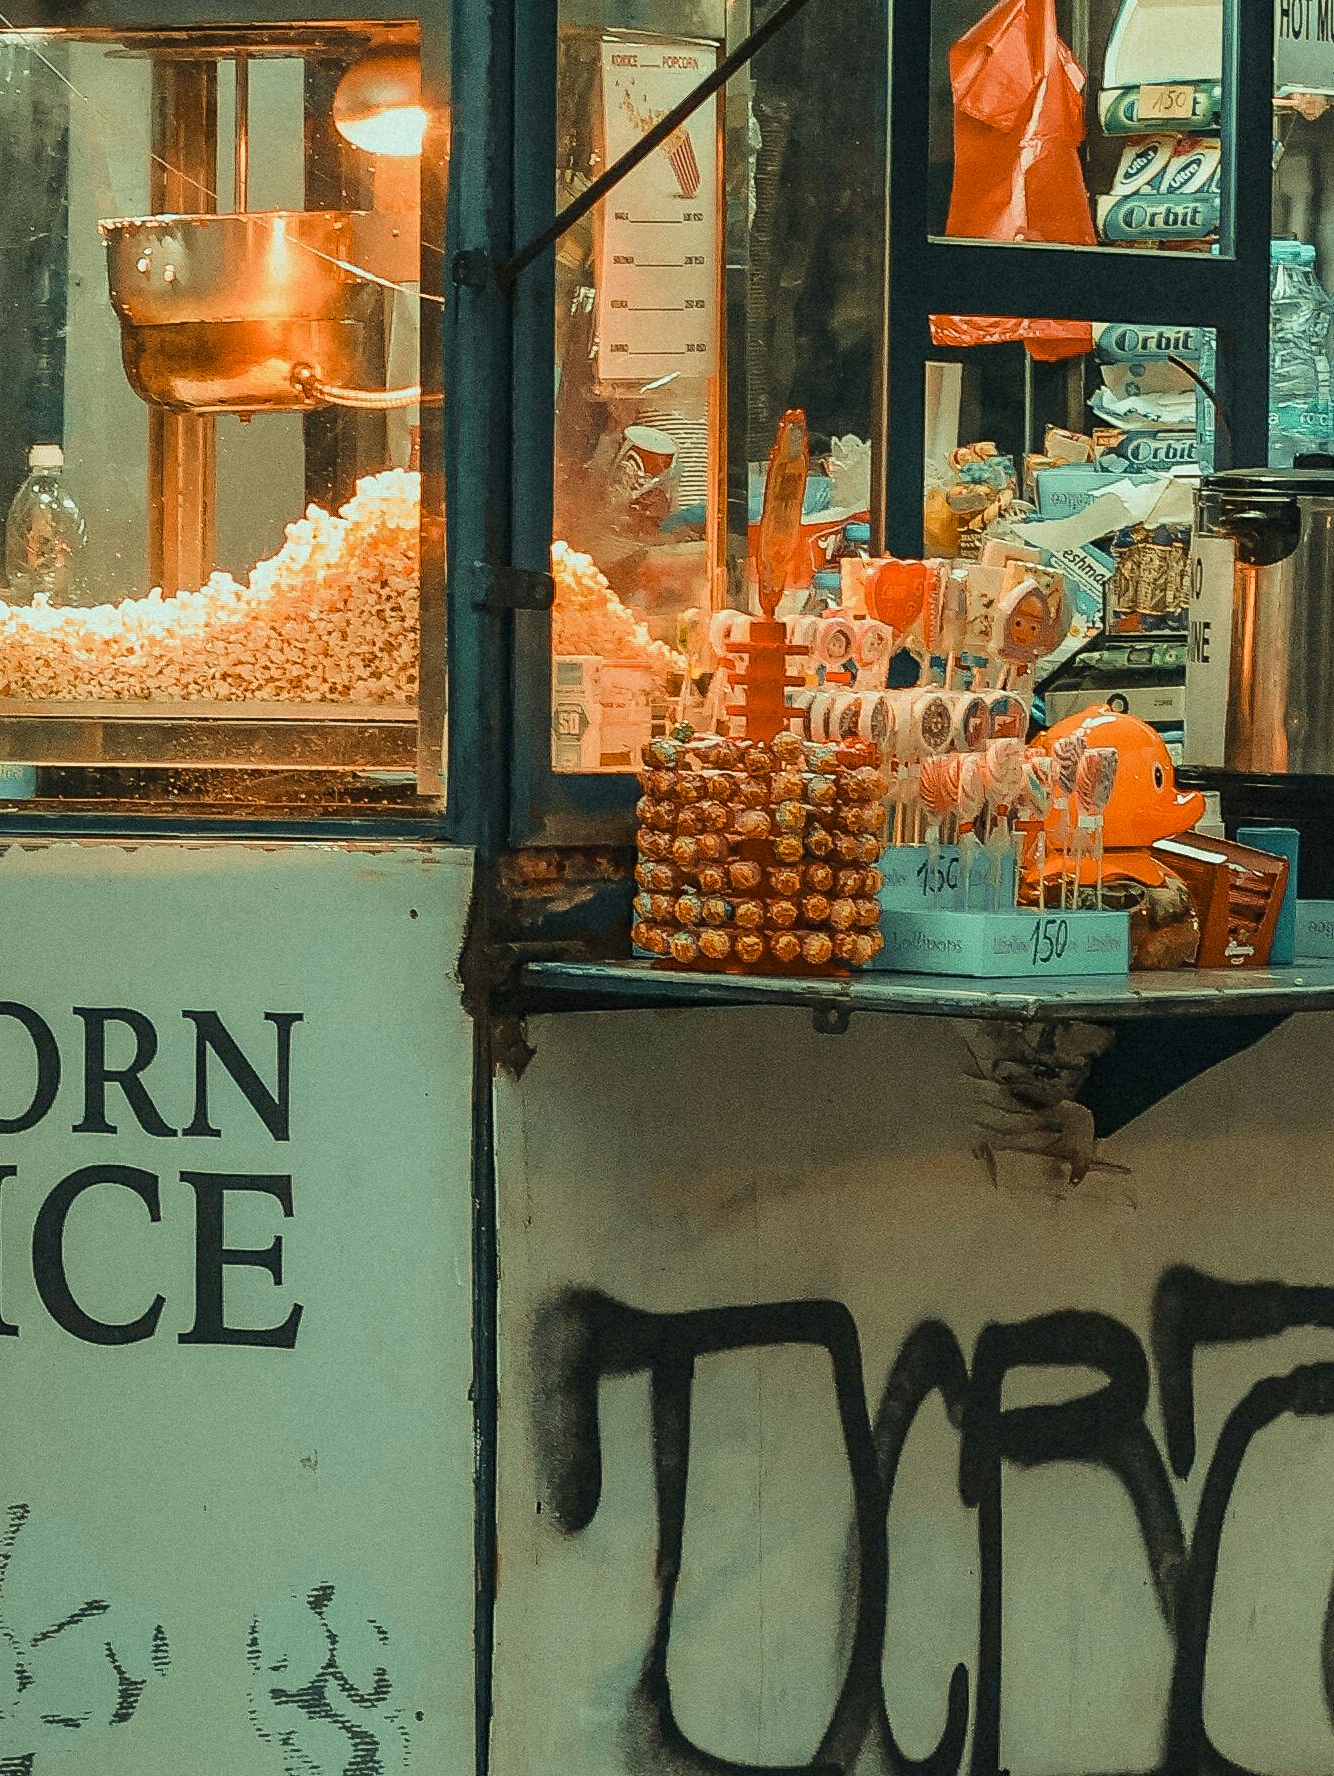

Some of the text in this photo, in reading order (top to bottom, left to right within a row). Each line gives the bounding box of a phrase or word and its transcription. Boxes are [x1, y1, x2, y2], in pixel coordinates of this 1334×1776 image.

[1152, 89, 1187, 113] 150
[1122, 204, 1201, 230] Orbit
[1114, 328, 1194, 353] Orbit
[1129, 439, 1198, 463] Orbit
[1030, 918, 1068, 966] 150
